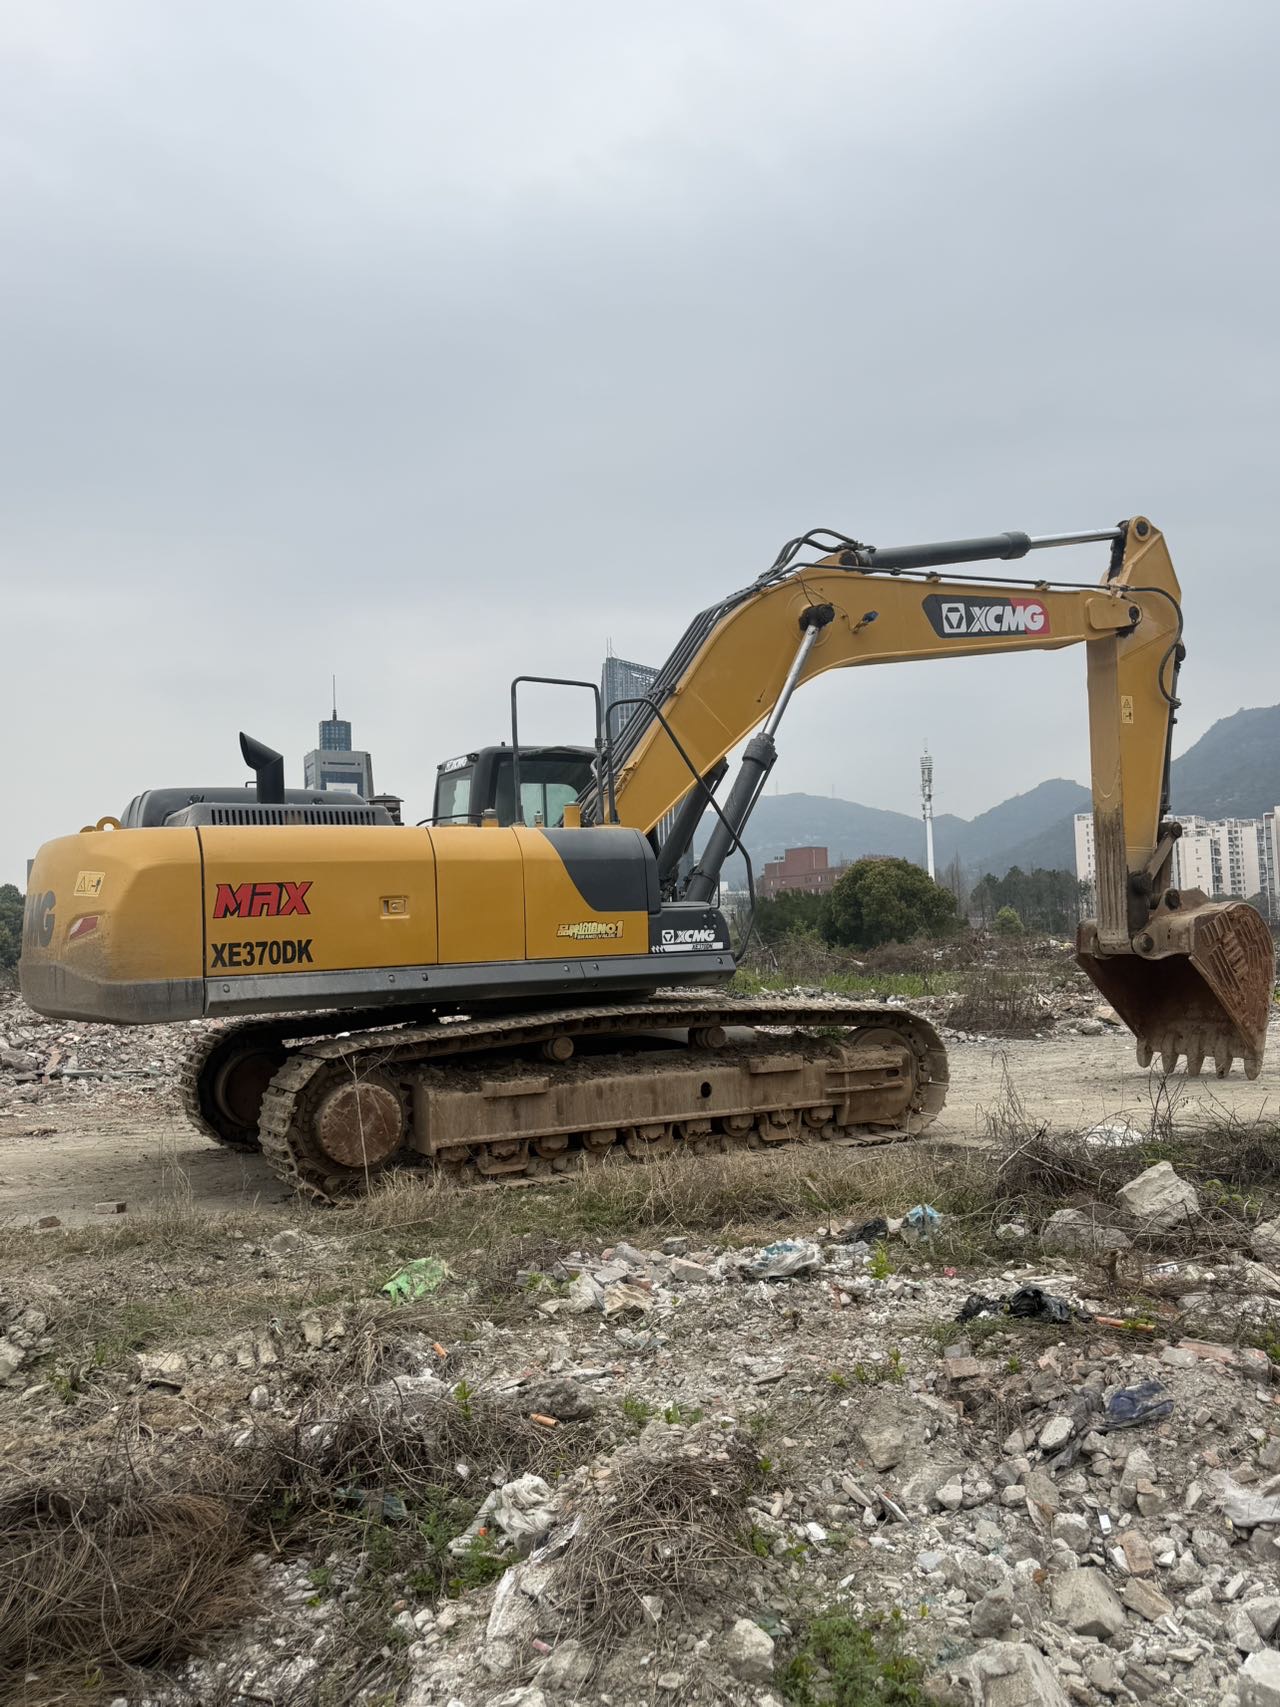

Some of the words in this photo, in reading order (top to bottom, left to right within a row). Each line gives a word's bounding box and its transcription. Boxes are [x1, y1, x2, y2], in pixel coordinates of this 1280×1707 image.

[967, 604, 1045, 633] XCMG
[213, 881, 314, 919] MAX
[674, 929, 716, 943] XCMG
[210, 939, 314, 968] XE370DK
